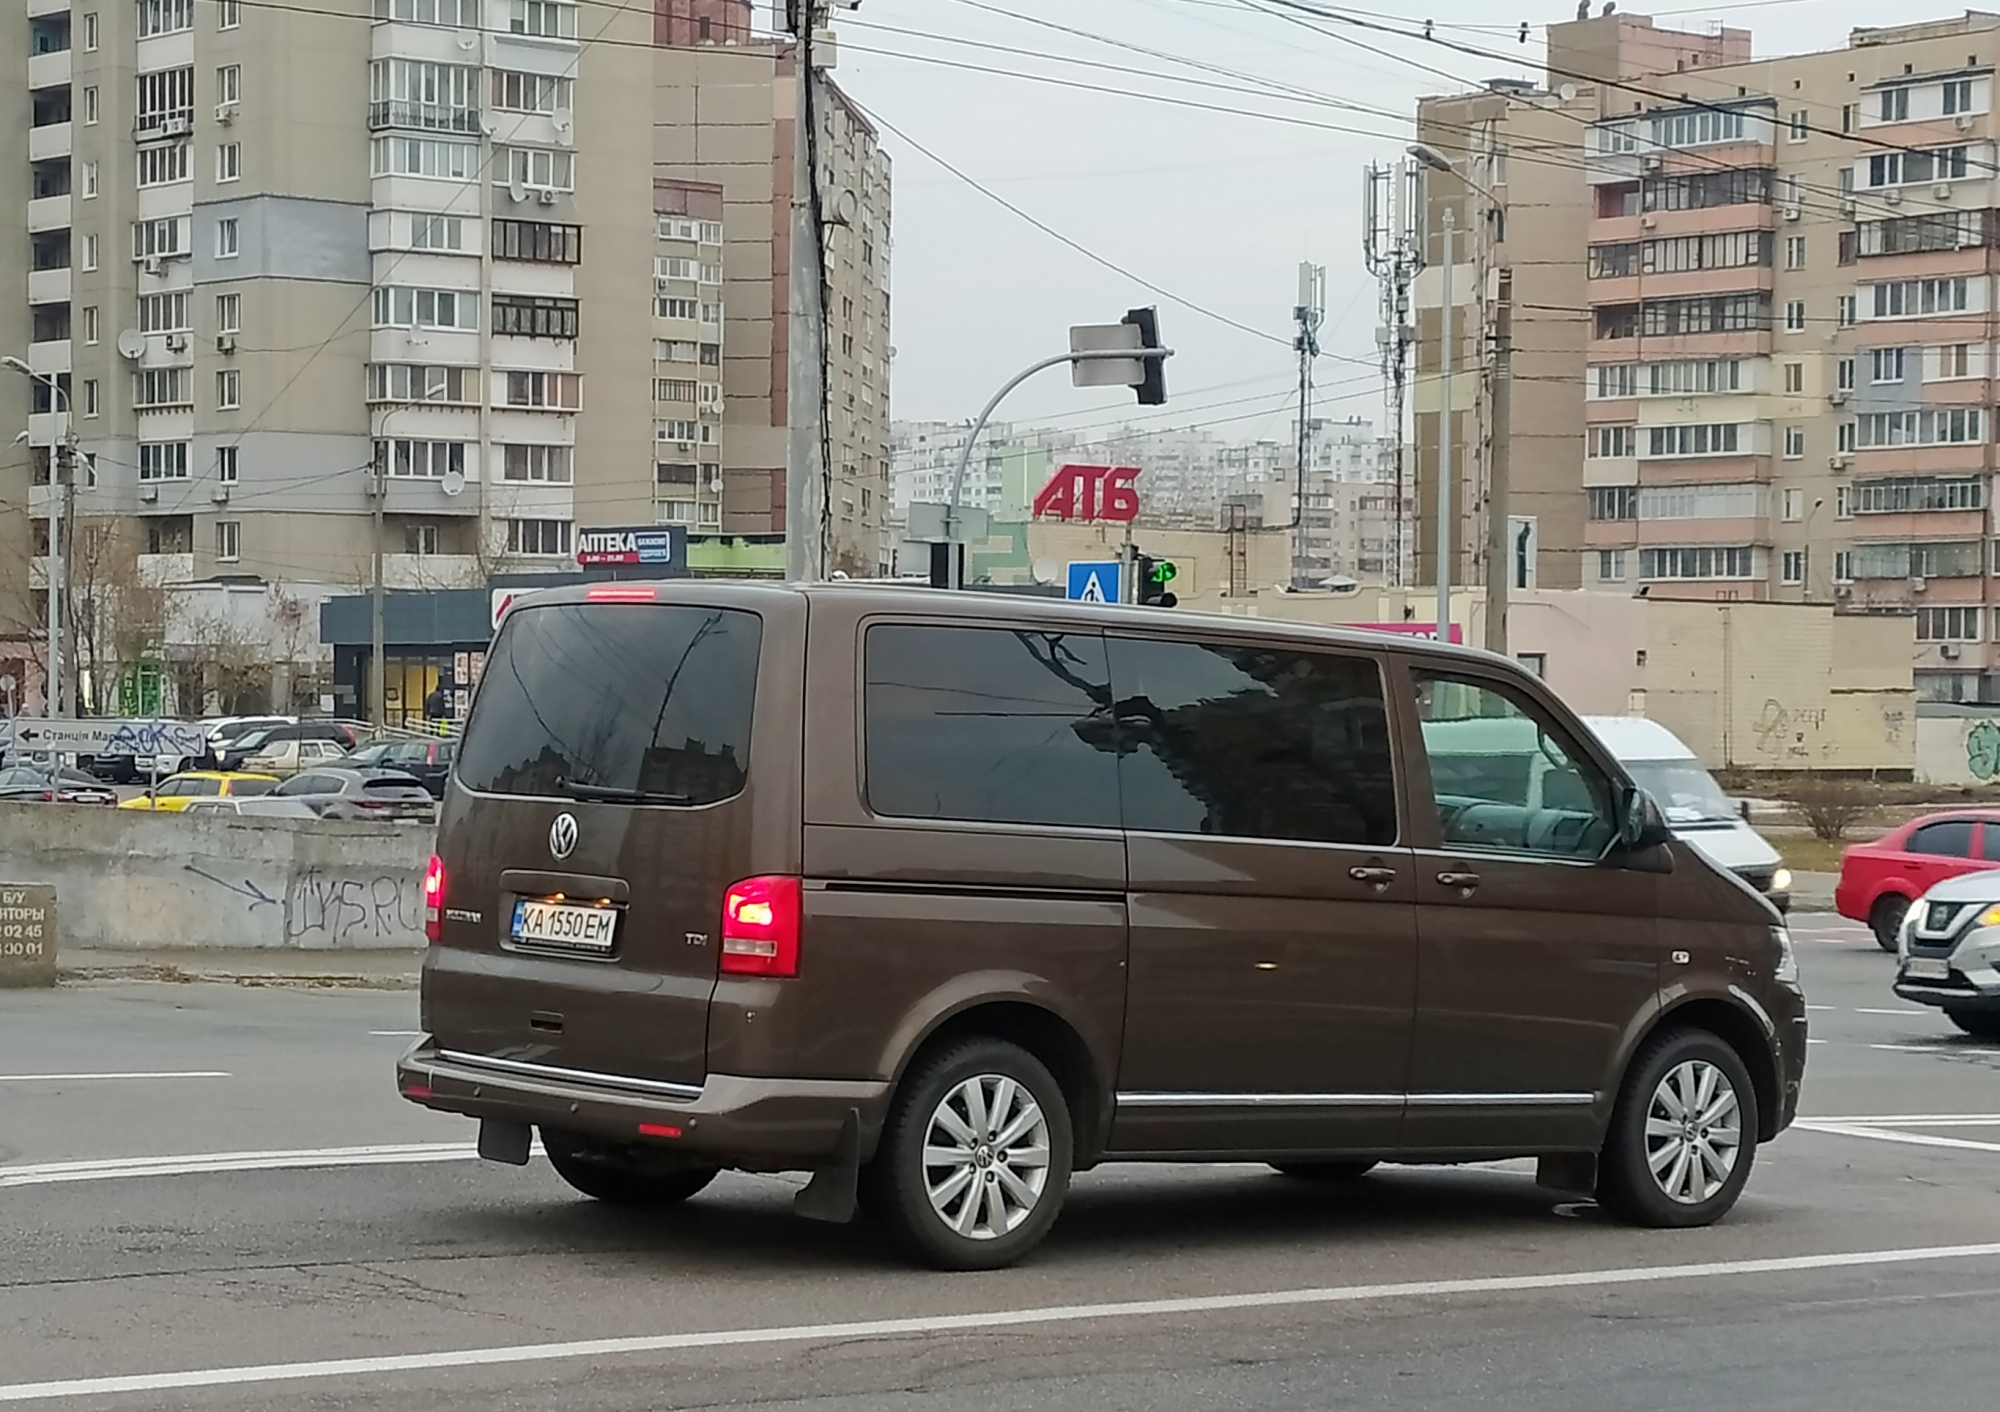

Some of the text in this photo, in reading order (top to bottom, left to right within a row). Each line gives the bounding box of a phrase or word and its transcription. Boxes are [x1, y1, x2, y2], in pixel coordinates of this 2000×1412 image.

[1033, 464, 1142, 520] АТБ
[578, 533, 637, 552] АПТЕКА
[43, 729, 89, 742] Станція
[2, 891, 26, 904] Б/У
[3, 924, 22, 938] 02
[24, 924, 42, 938] 45
[26, 942, 43, 955] 01
